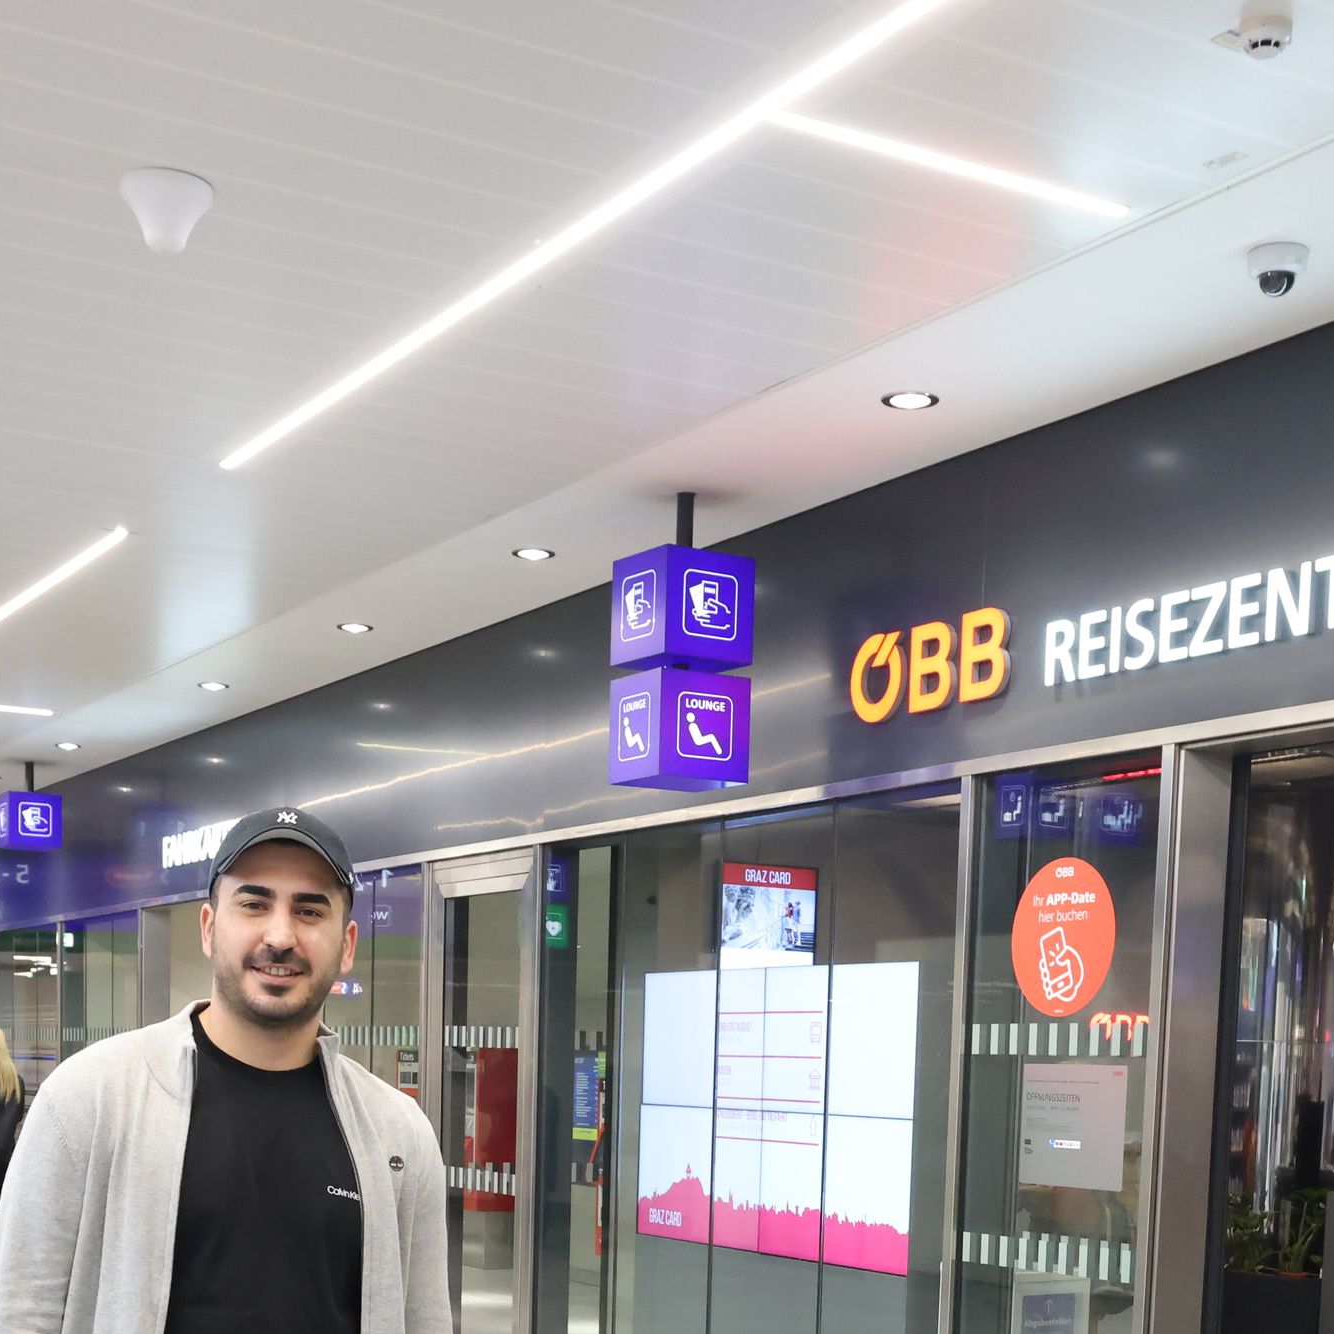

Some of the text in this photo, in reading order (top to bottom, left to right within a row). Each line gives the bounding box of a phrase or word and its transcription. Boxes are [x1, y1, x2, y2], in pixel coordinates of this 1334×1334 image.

[850, 606, 1008, 724] ÖBB
[622, 698, 647, 713] LOUNGE
[685, 697, 727, 712] LOUNGE
[744, 868, 791, 885] GRAZ CARD
[1055, 866, 1075, 878] ÖBB
[1033, 891, 1096, 907] Ihr APP-Date
[1038, 909, 1088, 923] hier buchen
[1025, 1092, 1081, 1104] ÖFFNUNGSZEITEN
[648, 1207, 683, 1228] GRAZ CARD
